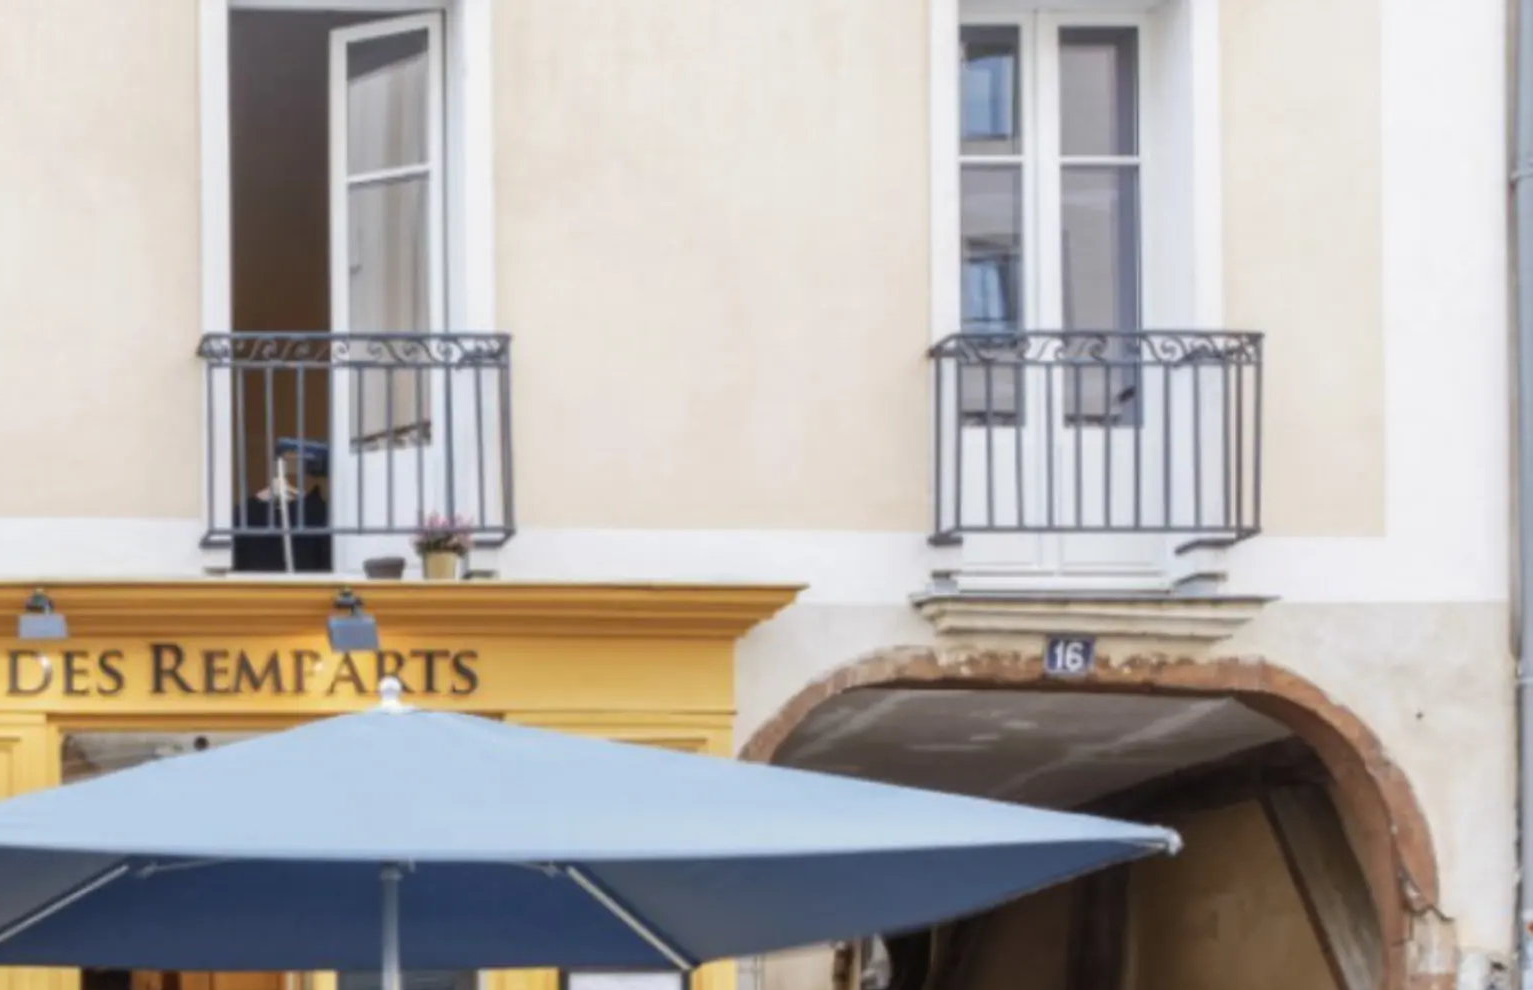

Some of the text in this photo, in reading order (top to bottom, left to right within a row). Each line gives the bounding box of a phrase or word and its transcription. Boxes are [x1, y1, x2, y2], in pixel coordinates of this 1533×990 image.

[6, 648, 125, 697] DES
[149, 642, 480, 697] REMPARTS
[1054, 641, 1084, 672] 16
